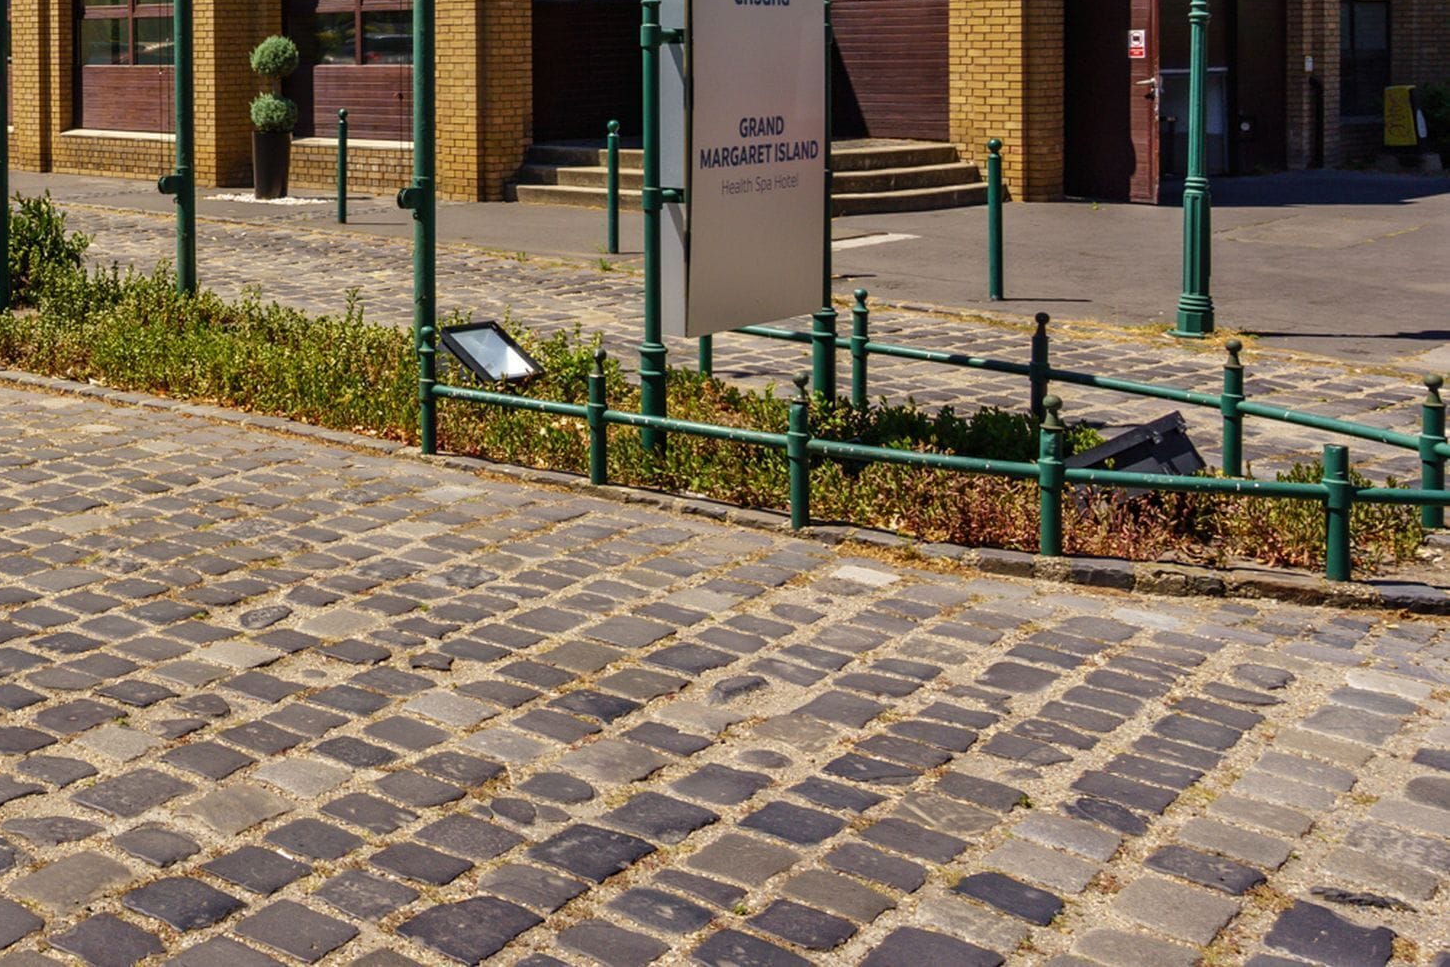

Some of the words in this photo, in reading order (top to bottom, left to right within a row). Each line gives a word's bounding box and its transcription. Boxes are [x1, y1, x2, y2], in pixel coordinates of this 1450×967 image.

[739, 116, 785, 138] GRAND
[700, 144, 772, 169] MARGARET
[774, 140, 819, 163] ISLAND
[721, 177, 753, 195] Health
[755, 176, 772, 194] Spa
[774, 174, 799, 189] Hotel
